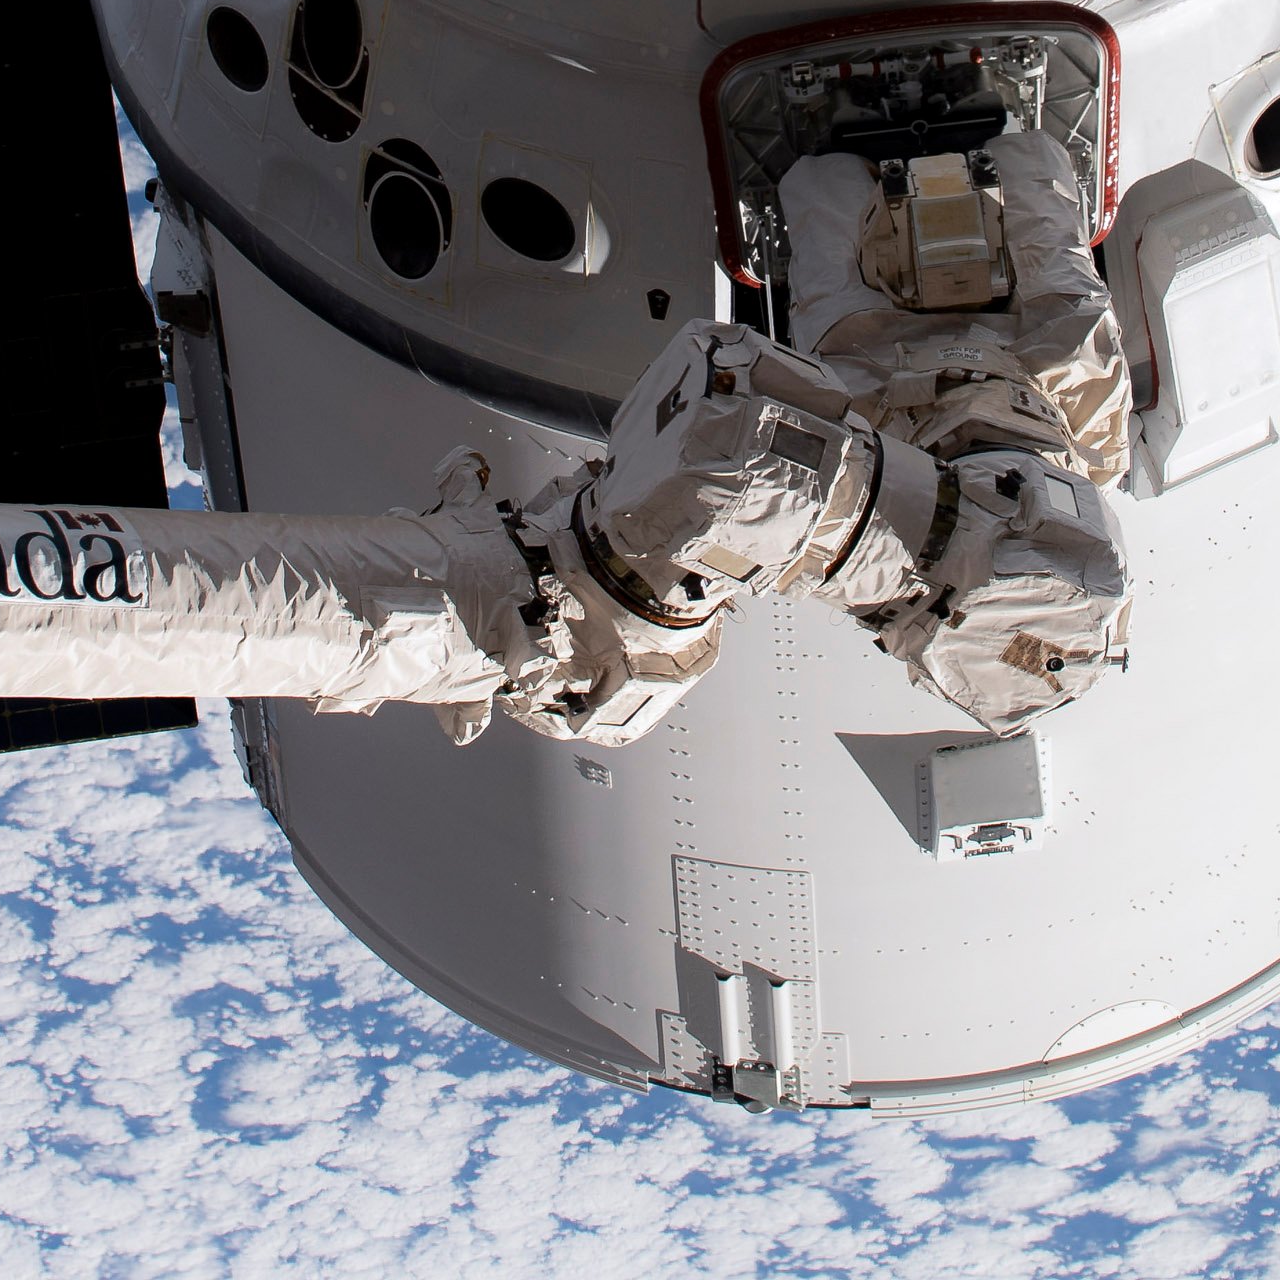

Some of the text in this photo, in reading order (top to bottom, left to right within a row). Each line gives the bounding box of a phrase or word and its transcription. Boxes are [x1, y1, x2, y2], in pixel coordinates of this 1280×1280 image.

[939, 346, 981, 355] OPEN FOR
[943, 352, 979, 360] GROUND
